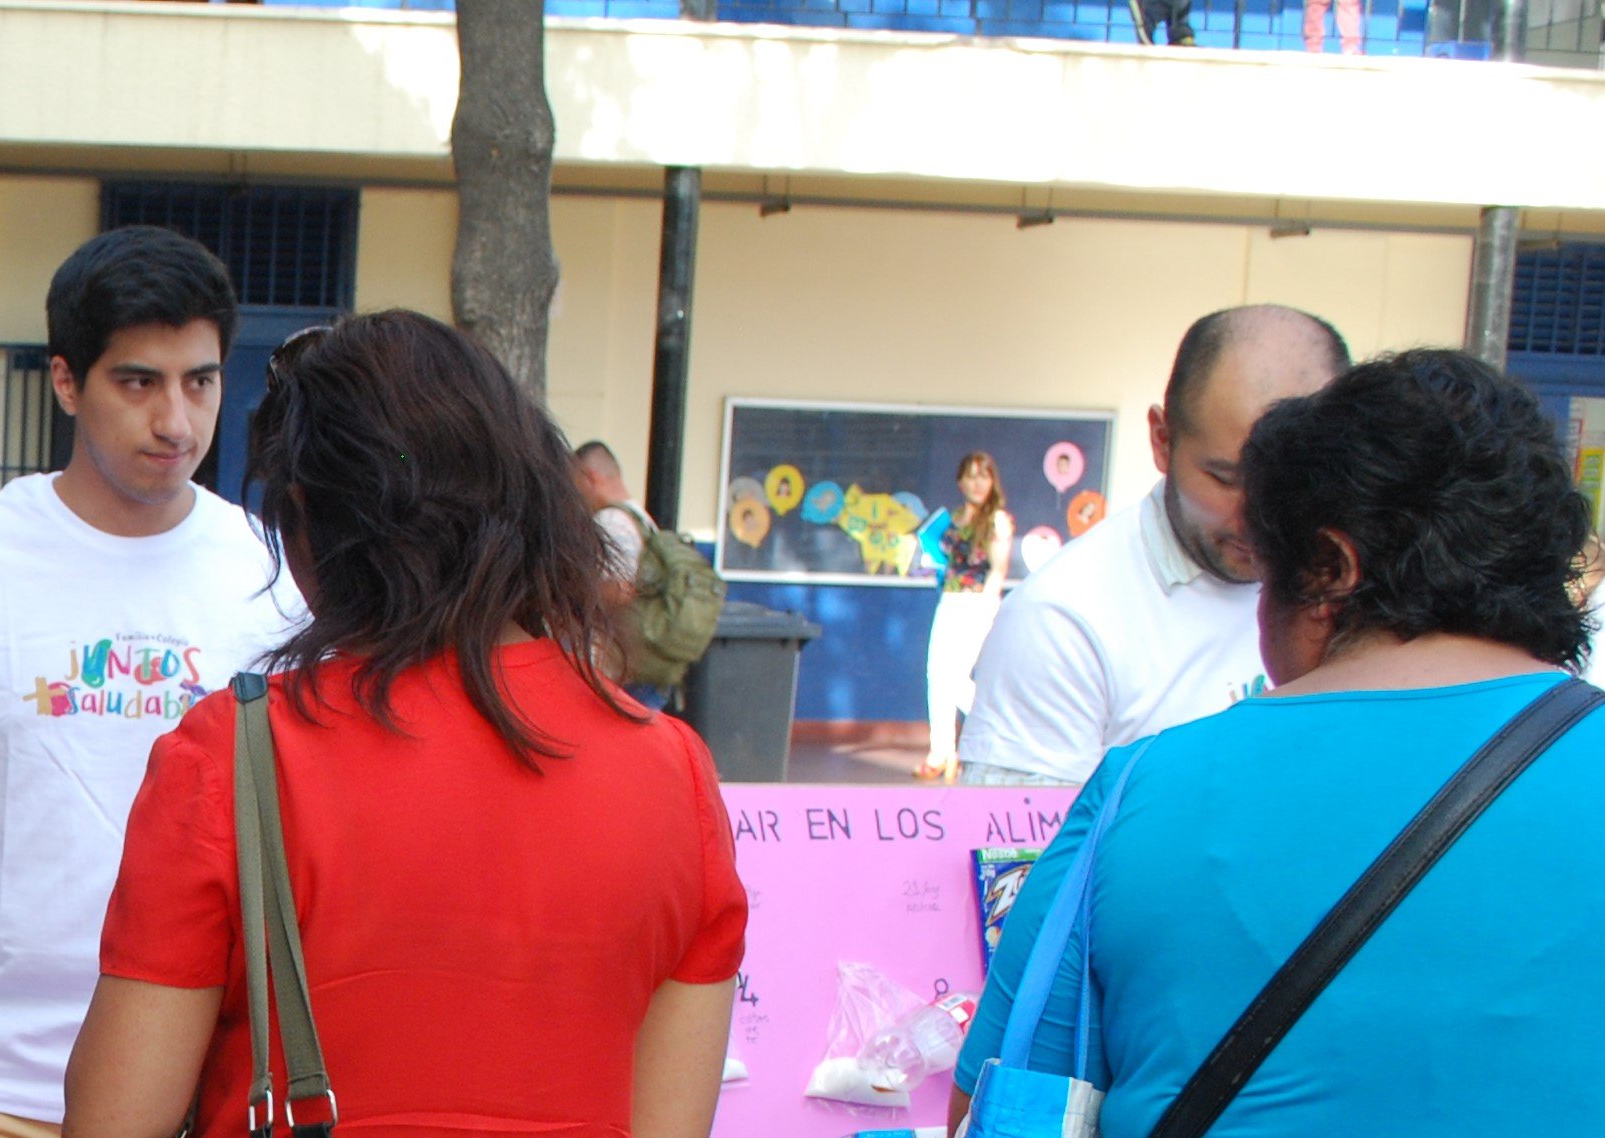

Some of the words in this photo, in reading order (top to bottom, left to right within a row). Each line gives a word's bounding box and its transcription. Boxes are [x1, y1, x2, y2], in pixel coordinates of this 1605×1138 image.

[735, 809, 781, 842] AR
[806, 808, 852, 841] EN
[875, 808, 945, 842] LOS
